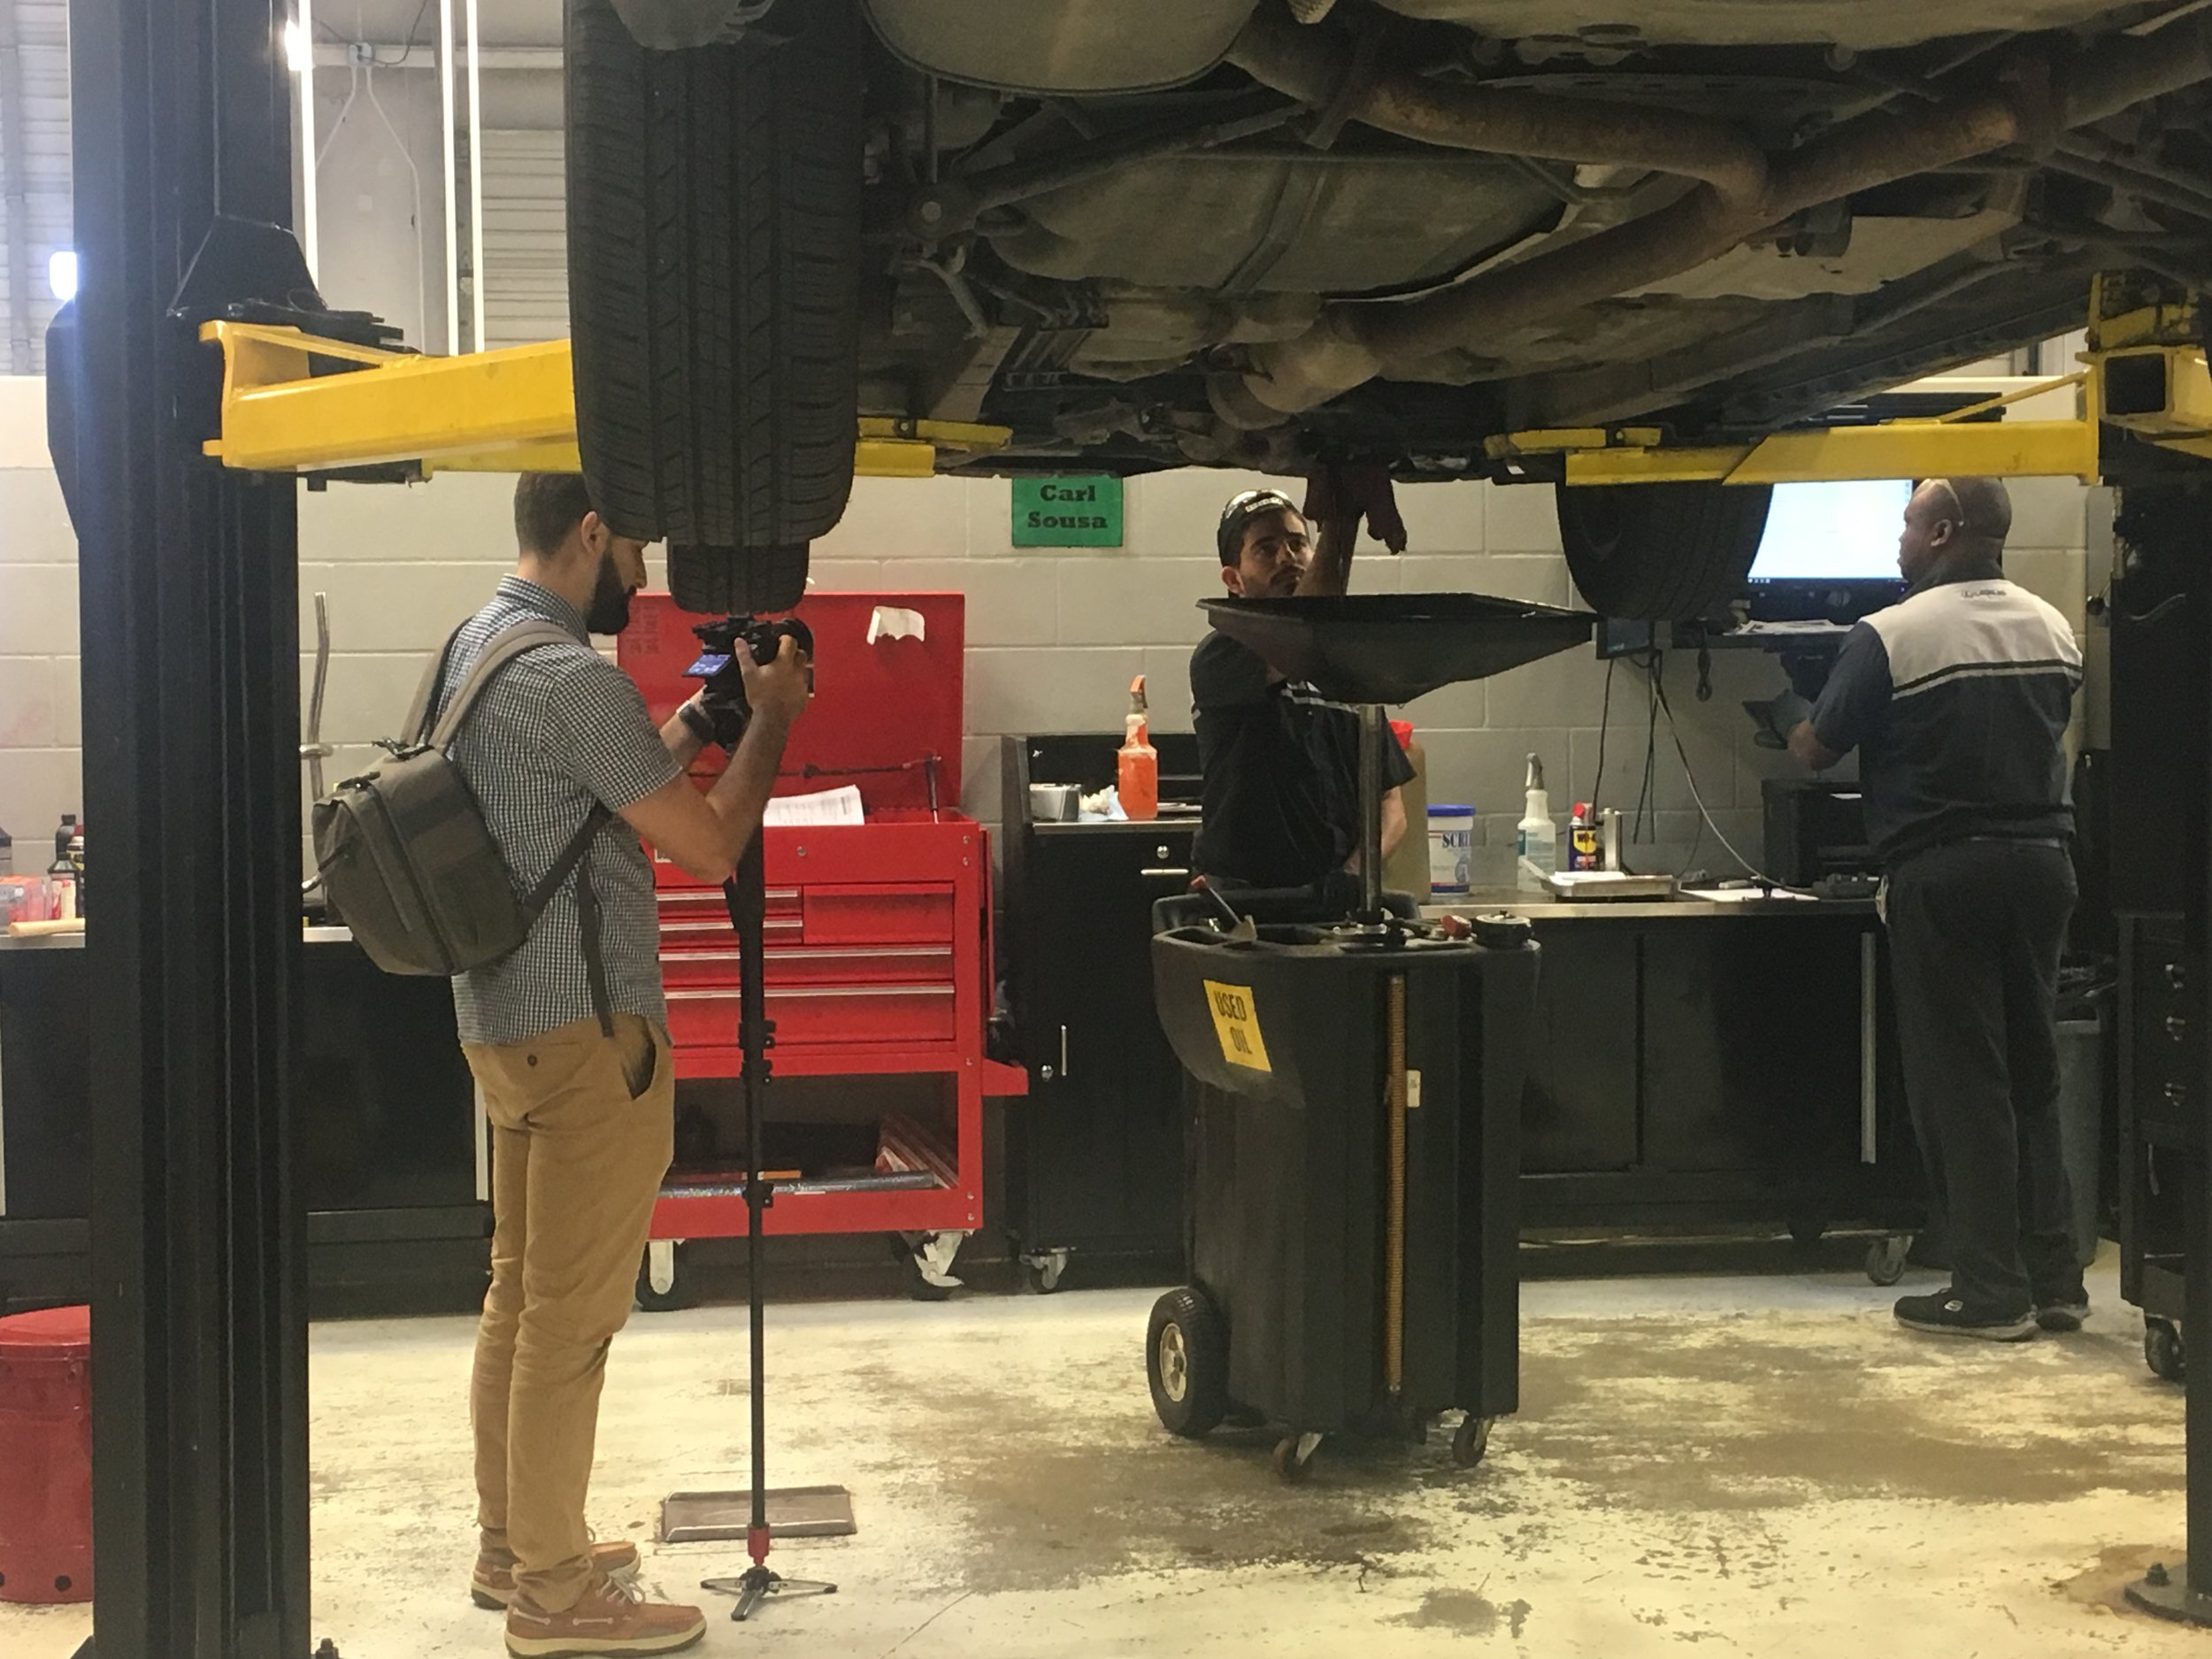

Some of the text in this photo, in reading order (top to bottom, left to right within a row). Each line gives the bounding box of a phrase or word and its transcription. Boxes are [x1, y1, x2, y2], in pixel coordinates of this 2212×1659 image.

[1040, 485, 1095, 502] Carl
[1027, 511, 1108, 528] Sousa
[1213, 990, 1247, 1021] USED
[1230, 1026, 1253, 1055] OIL
